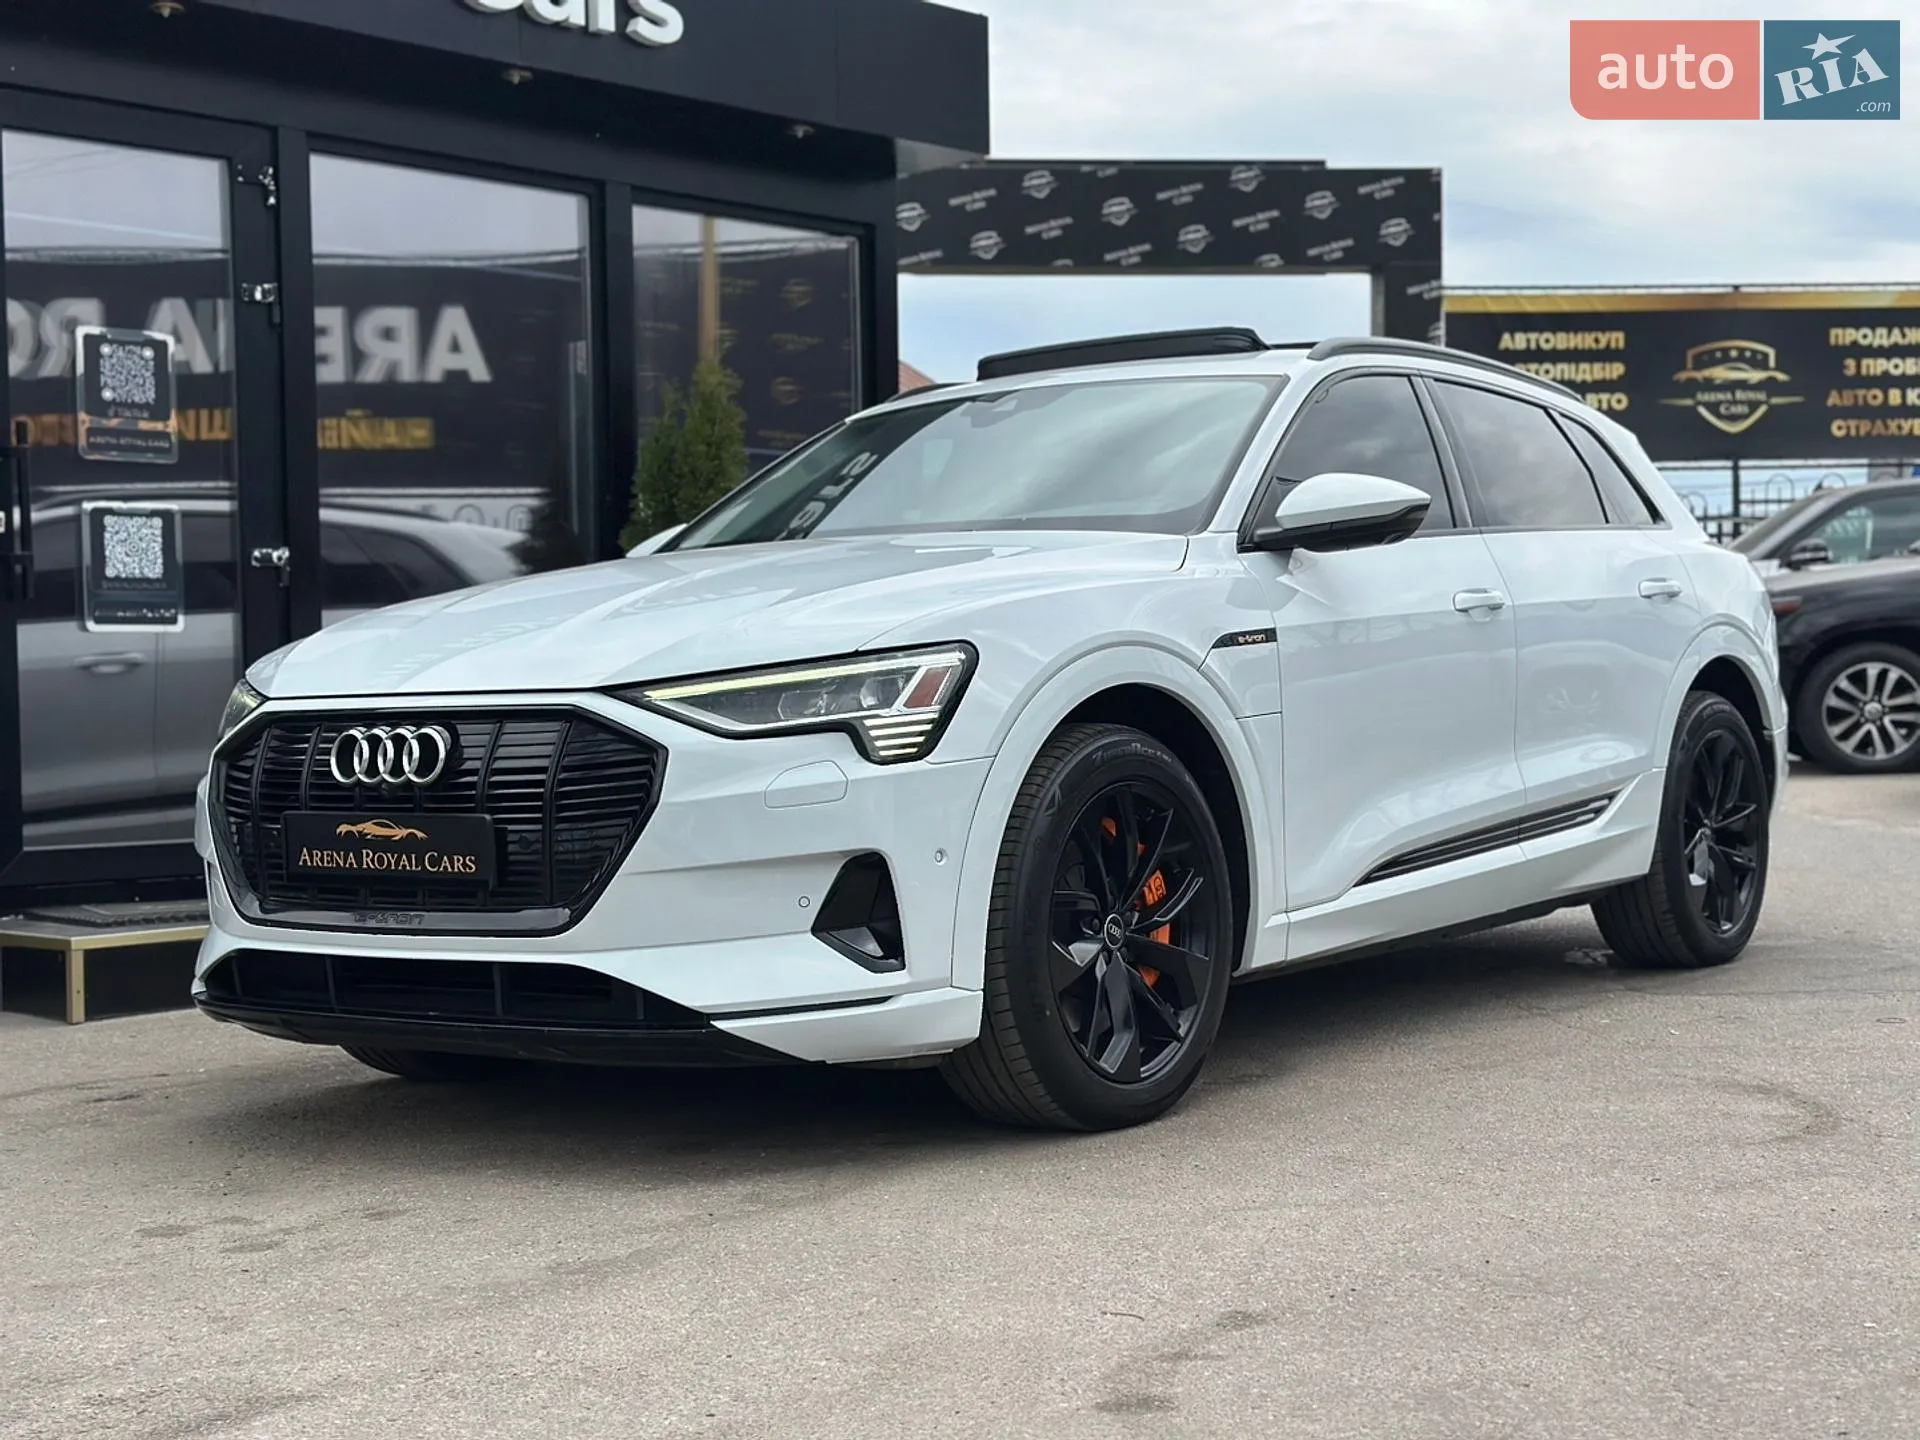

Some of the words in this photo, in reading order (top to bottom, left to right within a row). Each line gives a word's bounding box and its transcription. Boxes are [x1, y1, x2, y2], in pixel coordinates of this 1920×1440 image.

[1499, 331, 1625, 350] АВТОВИКУП
[1584, 392, 1629, 411] ВТО
[1826, 387, 1884, 407] АВТО
[1888, 388, 1902, 406] В
[298, 847, 357, 868] ARENA
[362, 849, 421, 871] ROYAL
[424, 852, 476, 873] CARS
